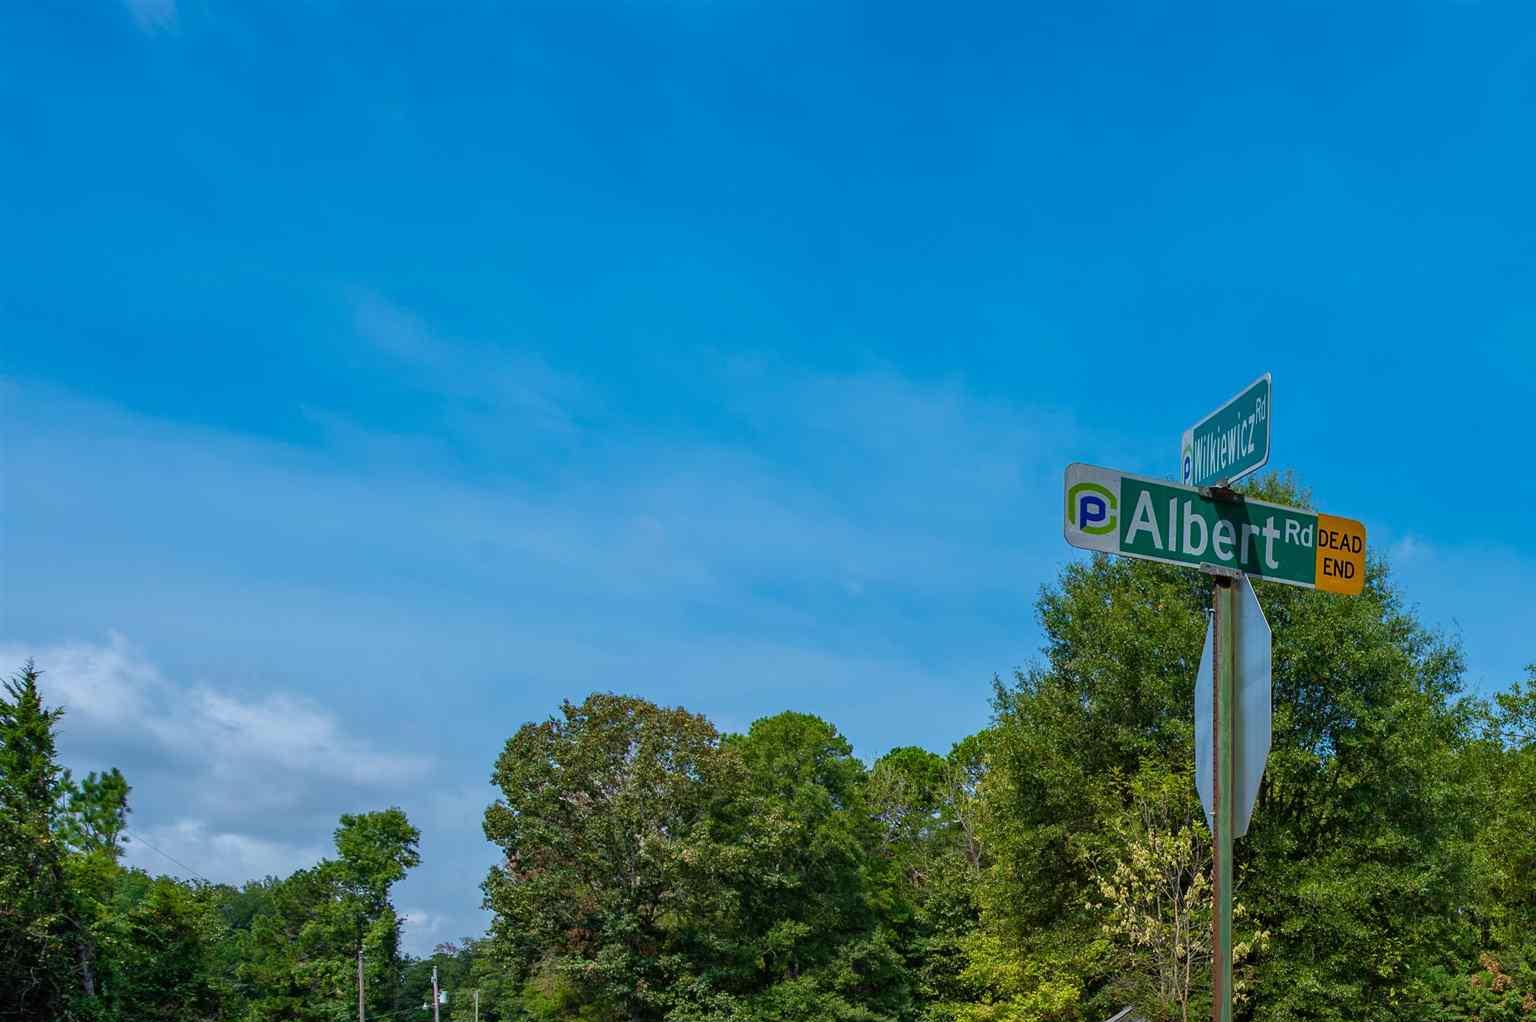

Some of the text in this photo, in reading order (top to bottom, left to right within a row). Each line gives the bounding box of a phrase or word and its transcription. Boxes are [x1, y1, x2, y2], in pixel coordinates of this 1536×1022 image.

[1194, 394, 1266, 484] Wilkiewicz Rd
[1124, 490, 1313, 569] Albert Rd
[1318, 529, 1362, 553] DEAD
[1323, 557, 1355, 579] END
